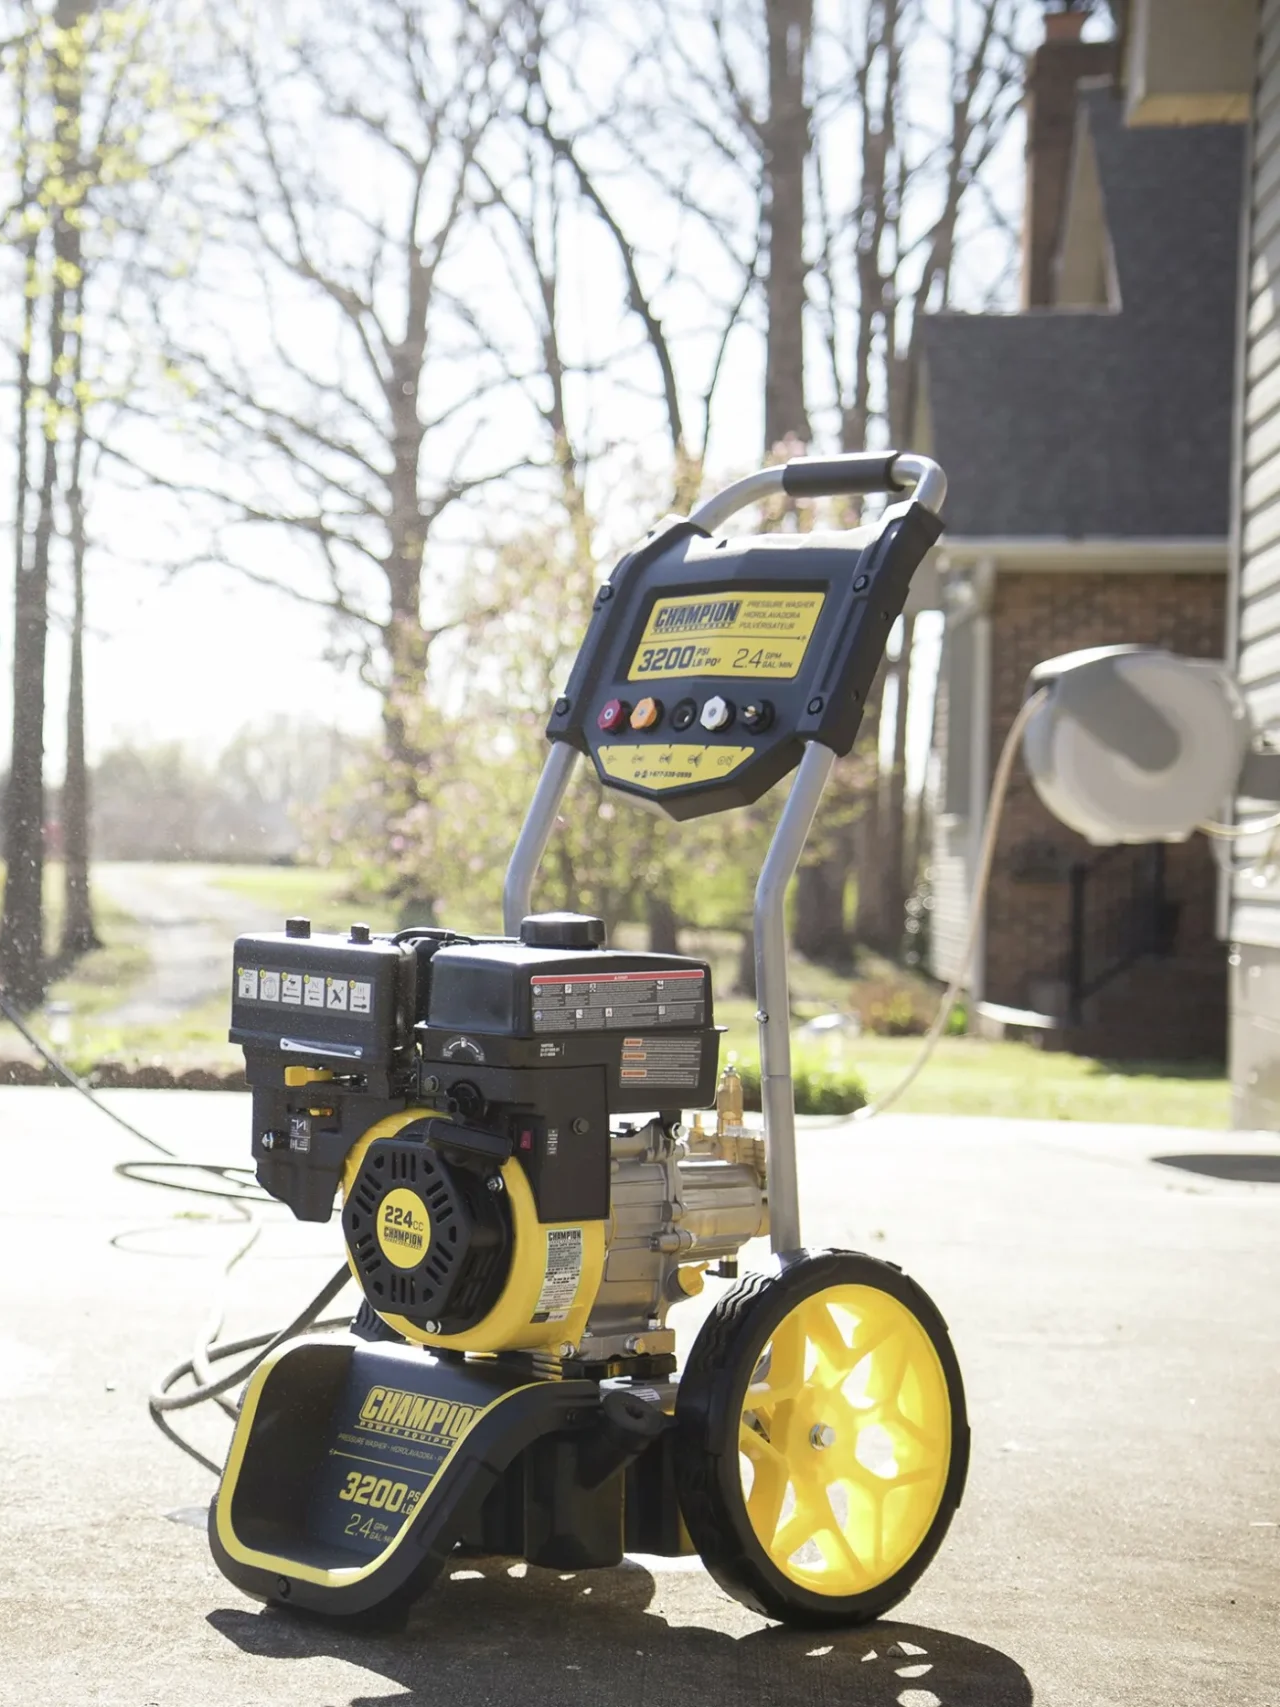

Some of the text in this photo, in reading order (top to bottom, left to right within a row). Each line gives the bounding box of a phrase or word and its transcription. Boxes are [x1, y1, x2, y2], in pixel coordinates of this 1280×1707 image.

[656, 601, 741, 627] CHAMPION
[638, 646, 695, 672] 3200
[695, 648, 711, 656] PSI
[732, 649, 765, 669] 2.4
[764, 652, 782, 660] GPM
[384, 1226, 423, 1248] CHAMPION
[548, 1230, 581, 1241] CHAMPION
[338, 1432, 365, 1446] PRESSURE
[364, 1438, 388, 1450] WASHER
[360, 1421, 456, 1446] POWER EQUIPM
[339, 1471, 409, 1513] 3200
[406, 1490, 422, 1502] PS
[344, 1513, 375, 1539] 2.4
[373, 1522, 389, 1533] GPM
